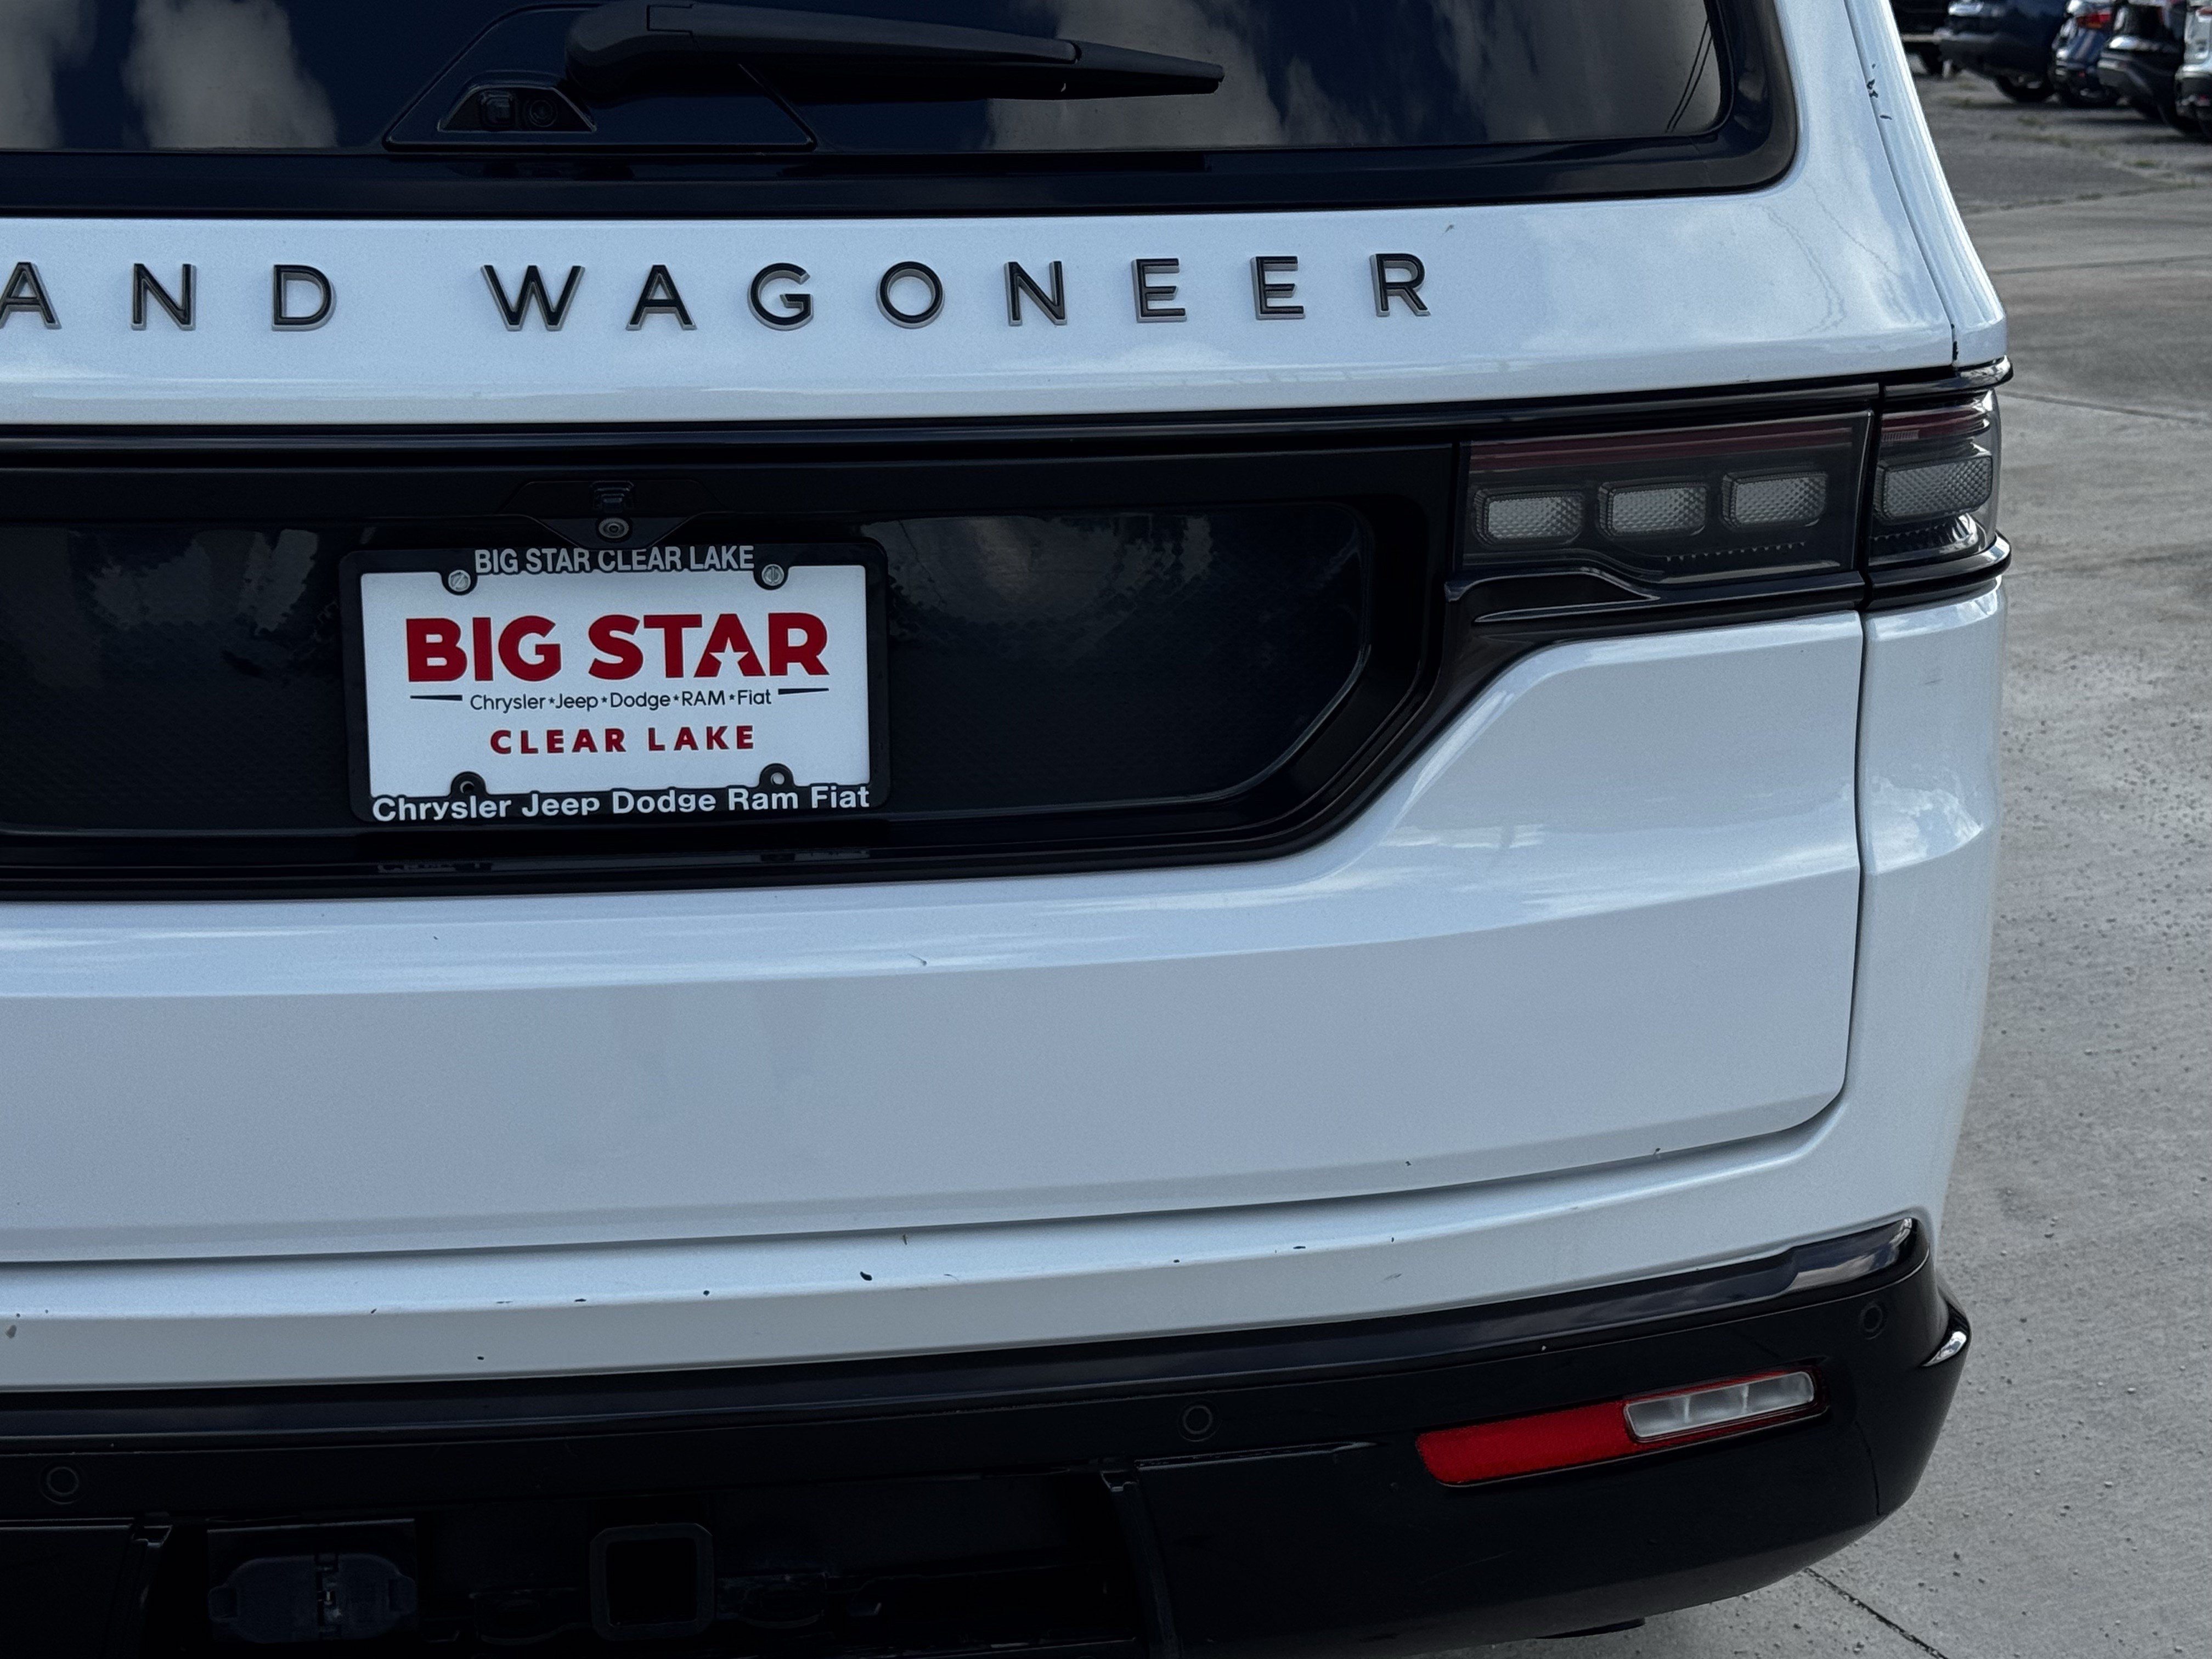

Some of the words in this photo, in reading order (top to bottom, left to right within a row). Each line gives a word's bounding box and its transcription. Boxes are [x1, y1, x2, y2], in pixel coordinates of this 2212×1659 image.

[479, 252, 1431, 332] WAGONEER
[475, 549, 519, 573] BIG
[526, 548, 590, 572] STAR
[597, 546, 682, 572] CLEAR
[689, 545, 754, 570] LAKE
[406, 616, 561, 682] BIG
[588, 612, 830, 680] STAR
[470, 693, 546, 713] Chrysler
[555, 693, 599, 712] Jeep
[610, 692, 671, 711] Dodge
[682, 690, 725, 707] RAM
[737, 689, 772, 706] Fiat
[490, 729, 626, 754] CLEAR
[648, 725, 754, 751] LAKE
[372, 795, 511, 821] Chrysler
[521, 793, 600, 816] Jeep
[612, 789, 716, 814] Dodge
[727, 788, 798, 811] Ram
[811, 786, 870, 809] Fiat
